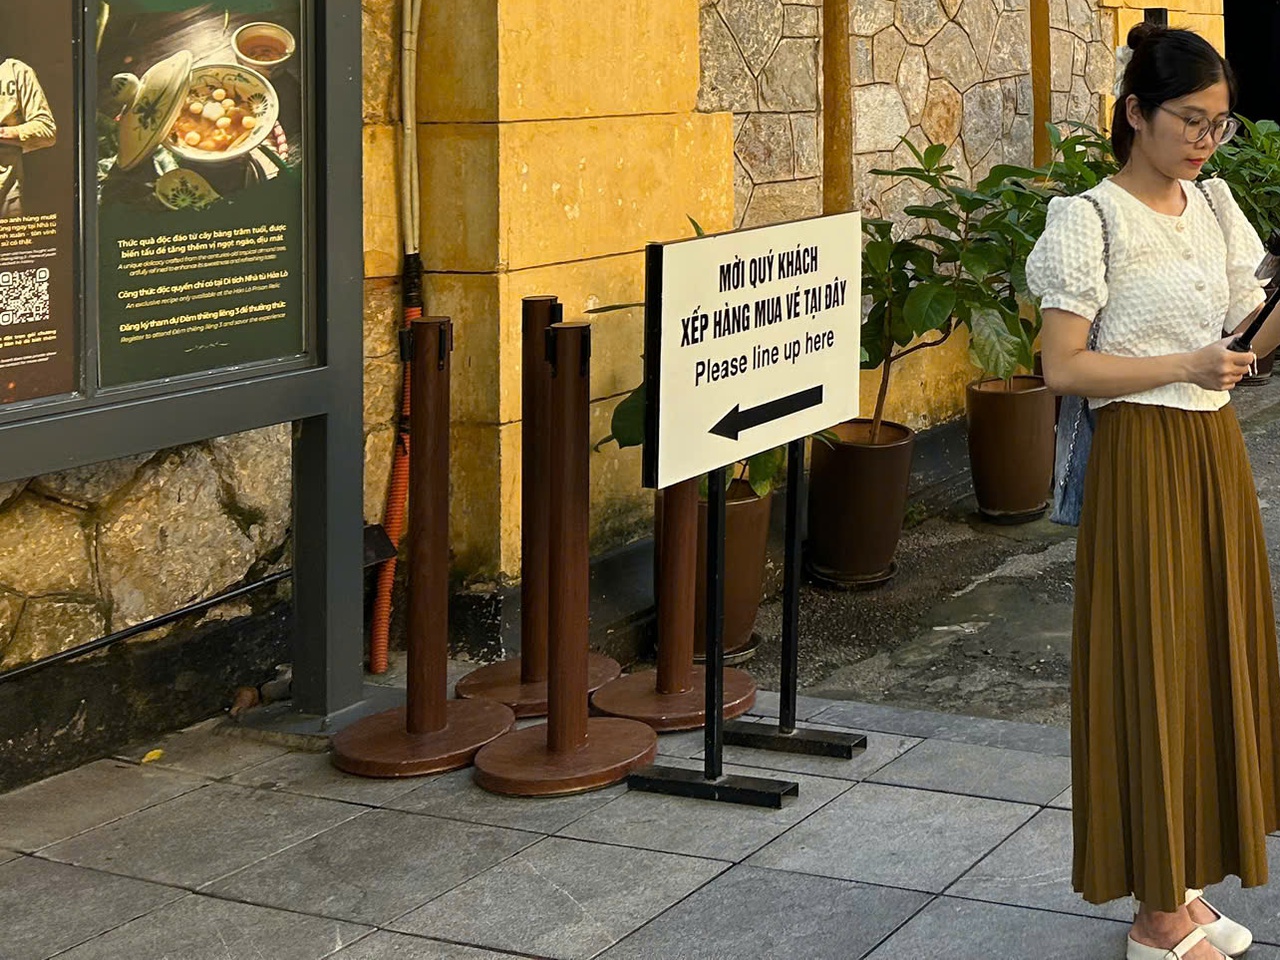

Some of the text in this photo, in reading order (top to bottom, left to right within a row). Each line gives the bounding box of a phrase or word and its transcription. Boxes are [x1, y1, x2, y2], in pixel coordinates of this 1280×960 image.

[117, 238, 138, 247] Thức
[156, 235, 171, 244] độc
[233, 227, 250, 235] trăm
[268, 224, 286, 232] được
[167, 245, 185, 253] tăng
[186, 242, 207, 251] thêm
[209, 240, 215, 249] vị
[216, 239, 234, 249] ngọt
[256, 235, 268, 244] dịu
[719, 244, 818, 292] MỜI QUÝ KHÁCH
[681, 277, 847, 347] XẾP HÀNG MUA VÉ TẠI ĐÂY
[695, 329, 834, 387] Please line up here
